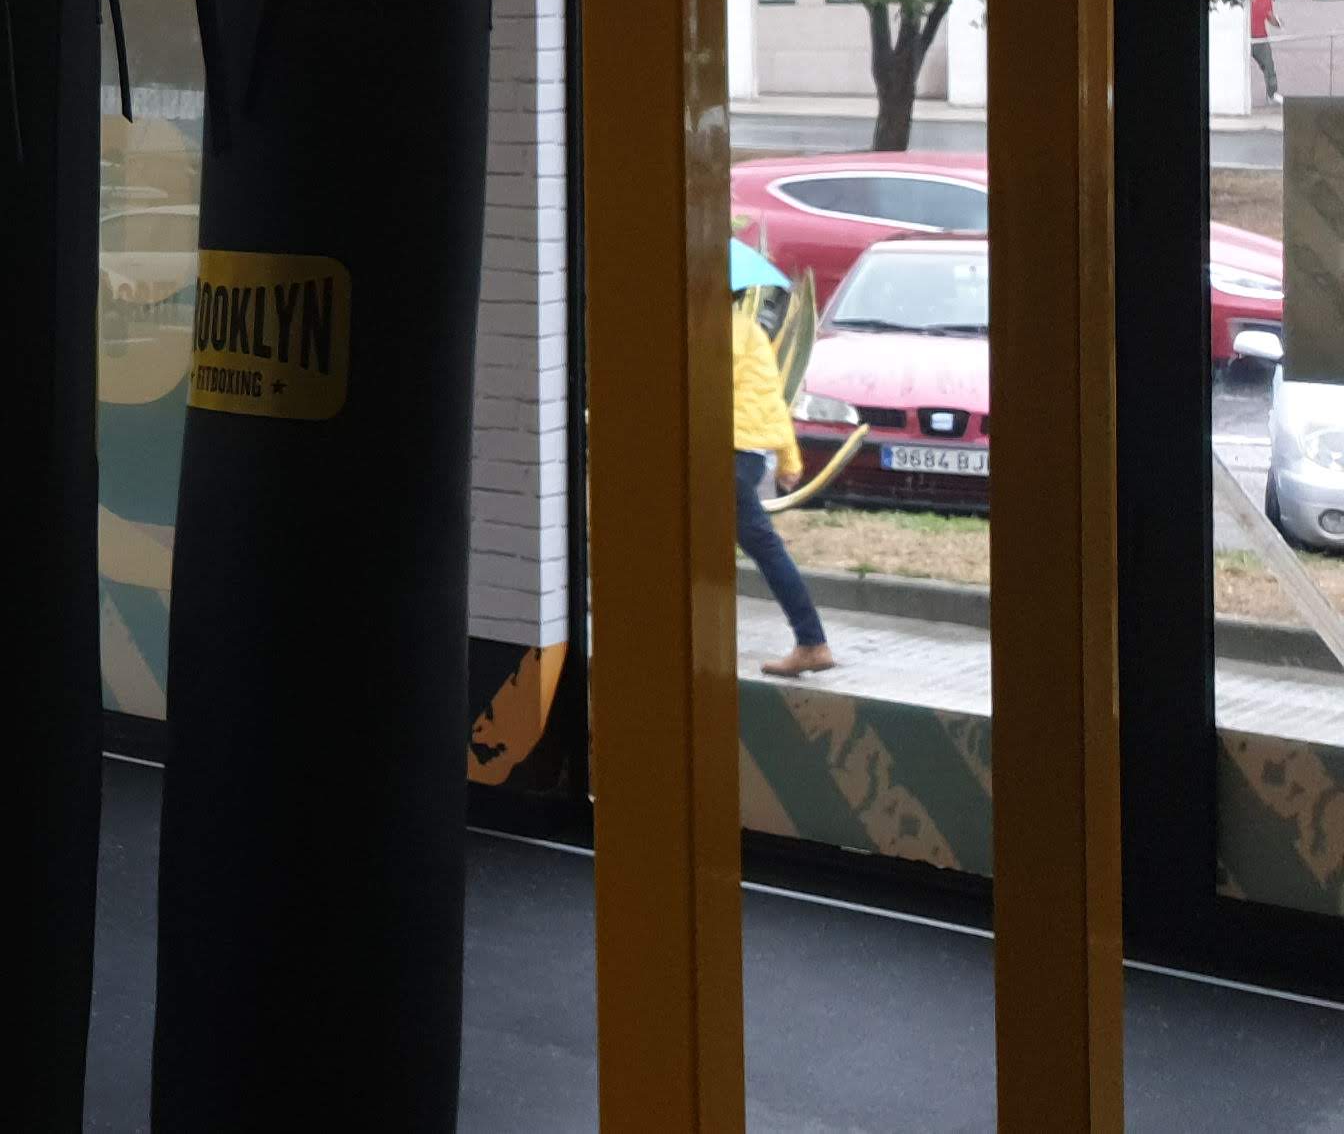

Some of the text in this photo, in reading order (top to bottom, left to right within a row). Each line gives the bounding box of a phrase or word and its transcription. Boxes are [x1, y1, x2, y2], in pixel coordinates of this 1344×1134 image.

[193, 276, 334, 375] OOKLYN
[196, 365, 263, 398] FITBOXING
[957, 450, 986, 472] BJ
